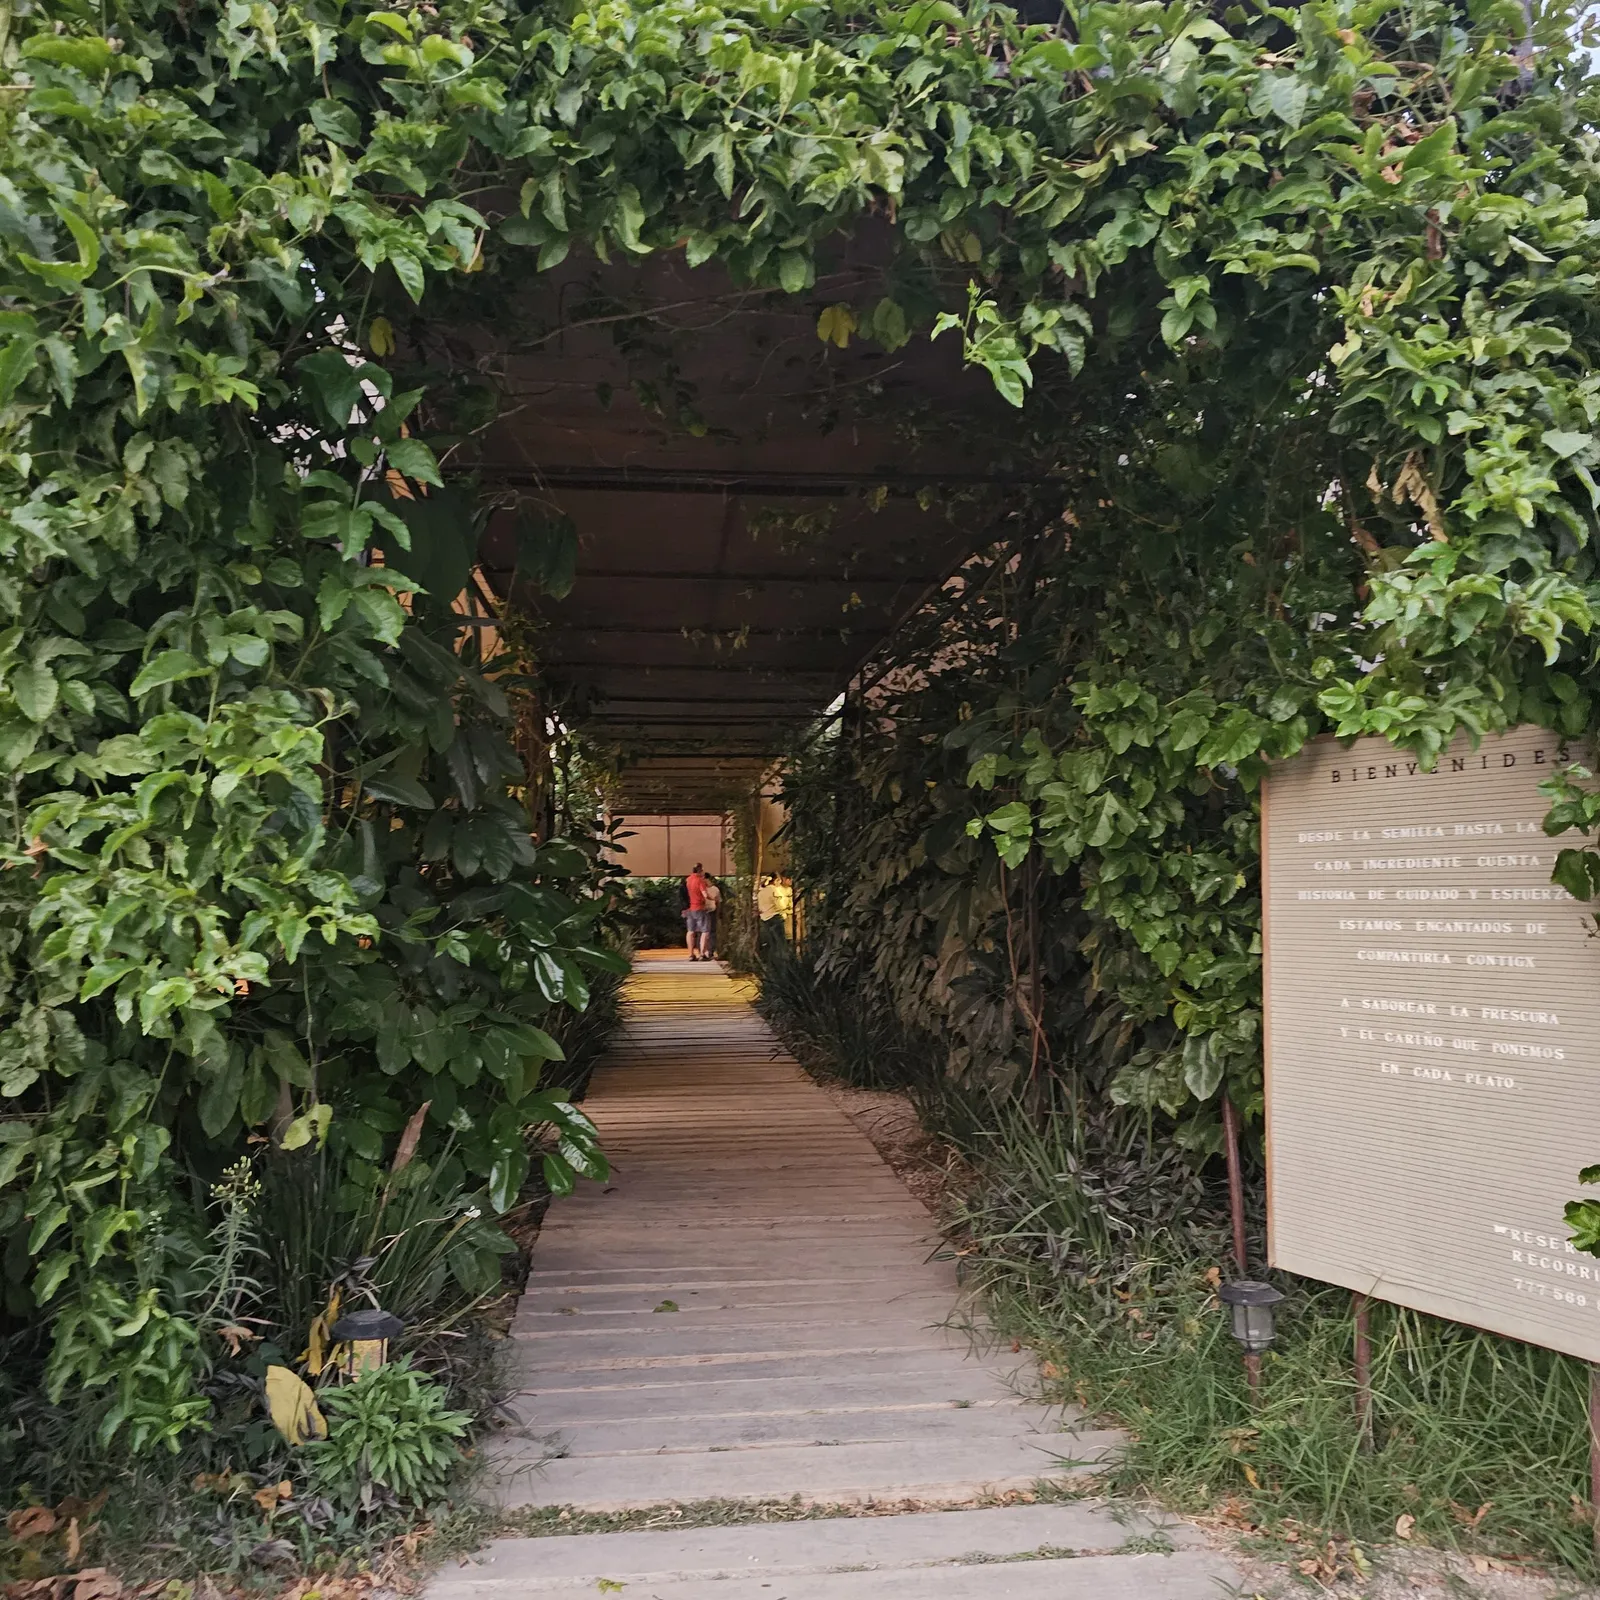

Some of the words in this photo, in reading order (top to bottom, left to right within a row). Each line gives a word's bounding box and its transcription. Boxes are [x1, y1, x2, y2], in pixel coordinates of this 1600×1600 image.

[1298, 831, 1343, 843] DESDE
[1352, 830, 1371, 841] LA
[1381, 826, 1445, 839] SEMILLA
[1454, 823, 1504, 836] HASTA
[1516, 822, 1537, 833] LA
[1313, 860, 1351, 871] CADA
[1362, 856, 1462, 870] INGREDIENTE
[1476, 854, 1540, 867] CUENTA
[1298, 890, 1356, 901] HISTORIA
[1368, 889, 1385, 901] DE
[1395, 889, 1460, 901] CUIDADO
[1469, 889, 1479, 901] Y
[1339, 920, 1402, 932] ESTAMOS
[1415, 921, 1513, 934] ENCANTADOS
[1525, 922, 1548, 935] DE
[1357, 950, 1452, 964] COMPARTIRLA
[1466, 954, 1536, 968] CONTIGX
[1340, 998, 1350, 1009] A
[1361, 999, 1437, 1014] SABOREAR
[1450, 1005, 1469, 1017] LA
[1481, 1007, 1560, 1025] FRESCURA
[1340, 1026, 1349, 1038] Y
[1359, 1029, 1376, 1041] EL
[1384, 1030, 1444, 1048] CARIÑO
[1452, 1038, 1480, 1051] QUE
[1492, 1042, 1566, 1061] PONEMOS
[1381, 1062, 1400, 1074] EN
[1413, 1066, 1453, 1082] CADA
